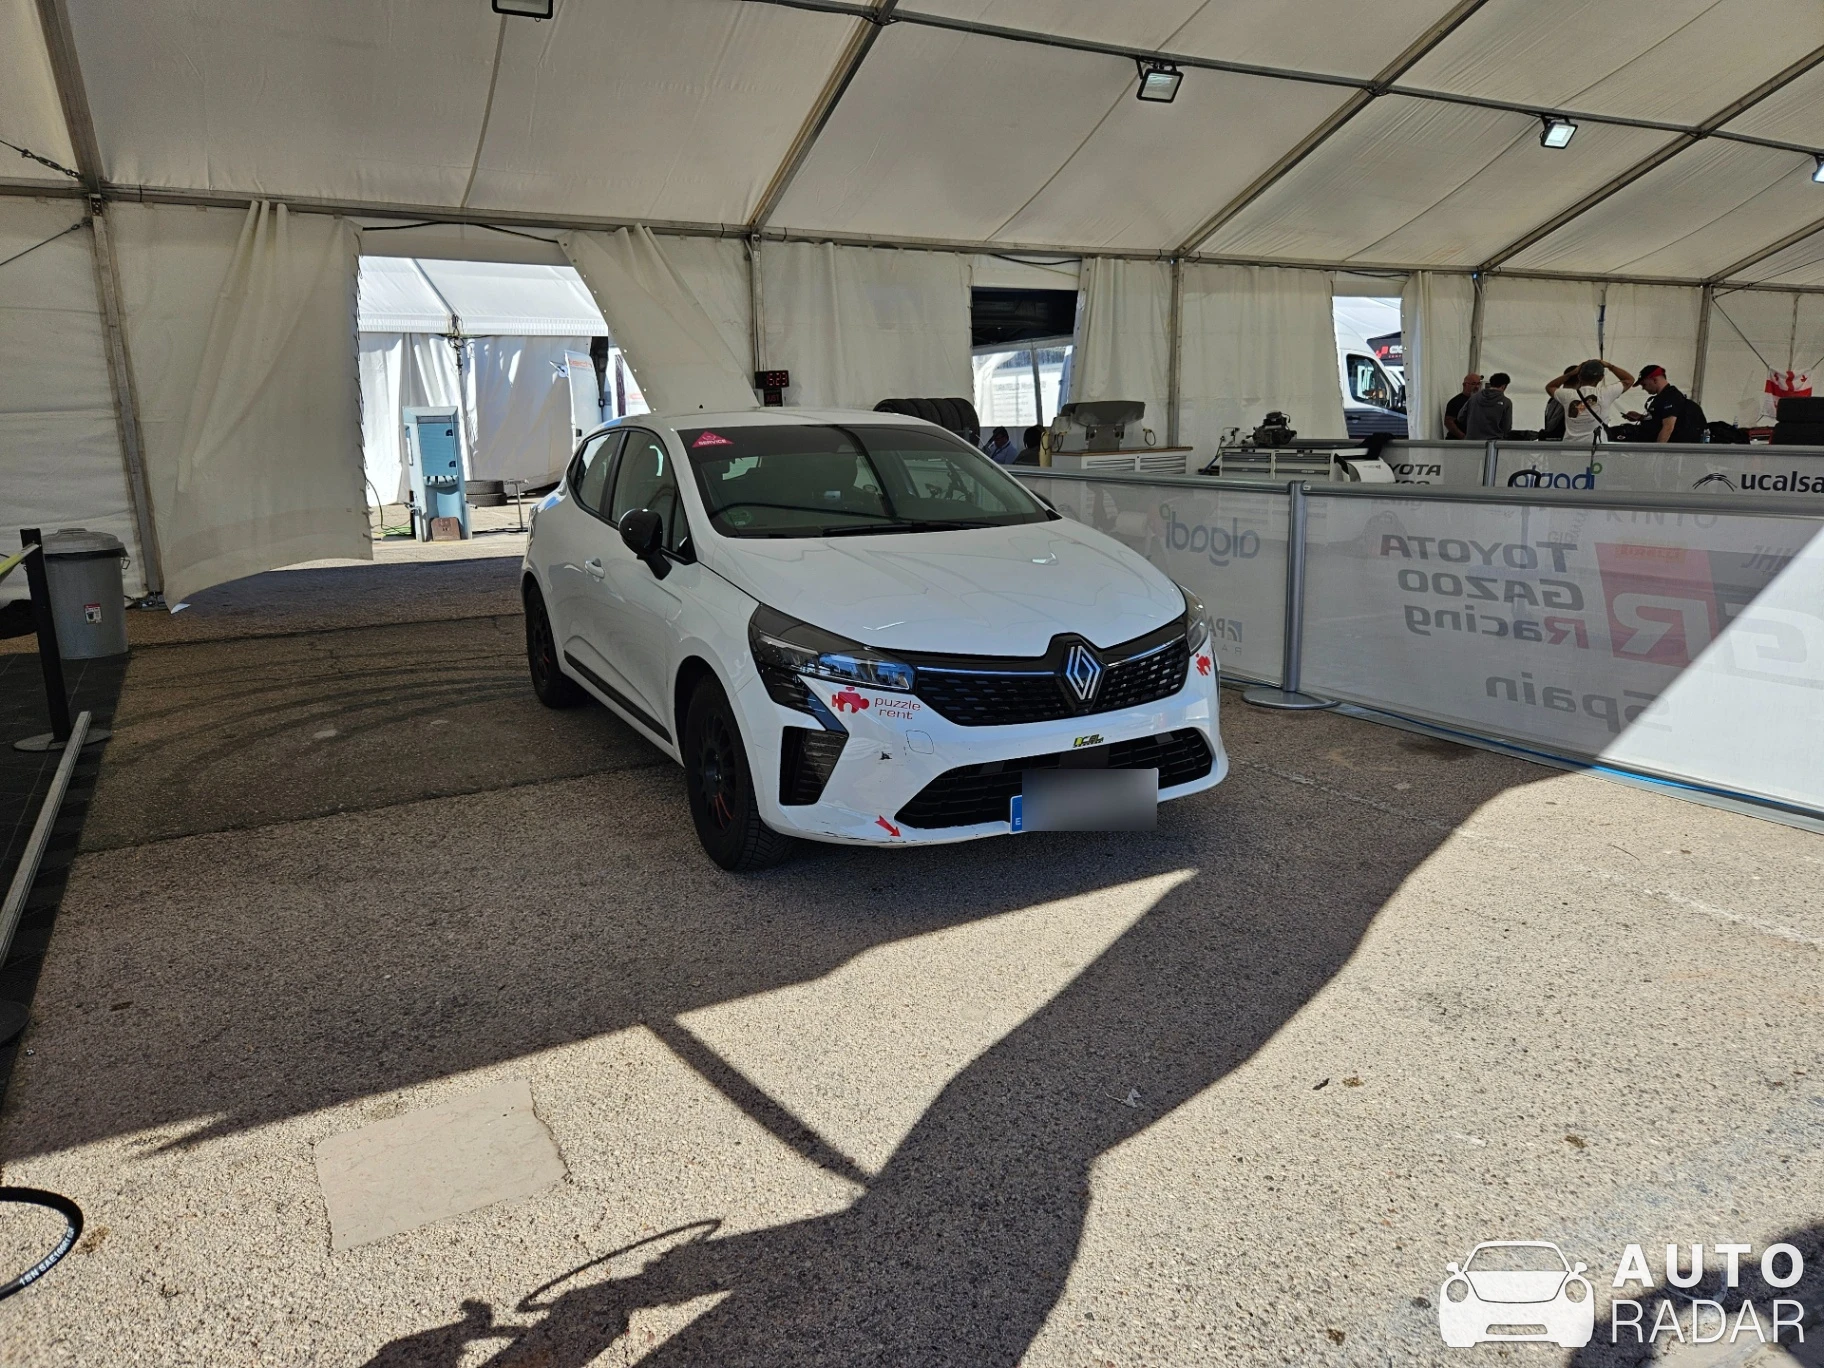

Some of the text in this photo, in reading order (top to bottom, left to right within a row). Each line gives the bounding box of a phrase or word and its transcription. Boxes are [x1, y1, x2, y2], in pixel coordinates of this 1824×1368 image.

[698, 438, 727, 446] SERVICE
[1387, 463, 1442, 476] YOTA
[874, 697, 921, 712] puzzle
[879, 709, 913, 720] rent
[1015, 817, 1022, 826] E
